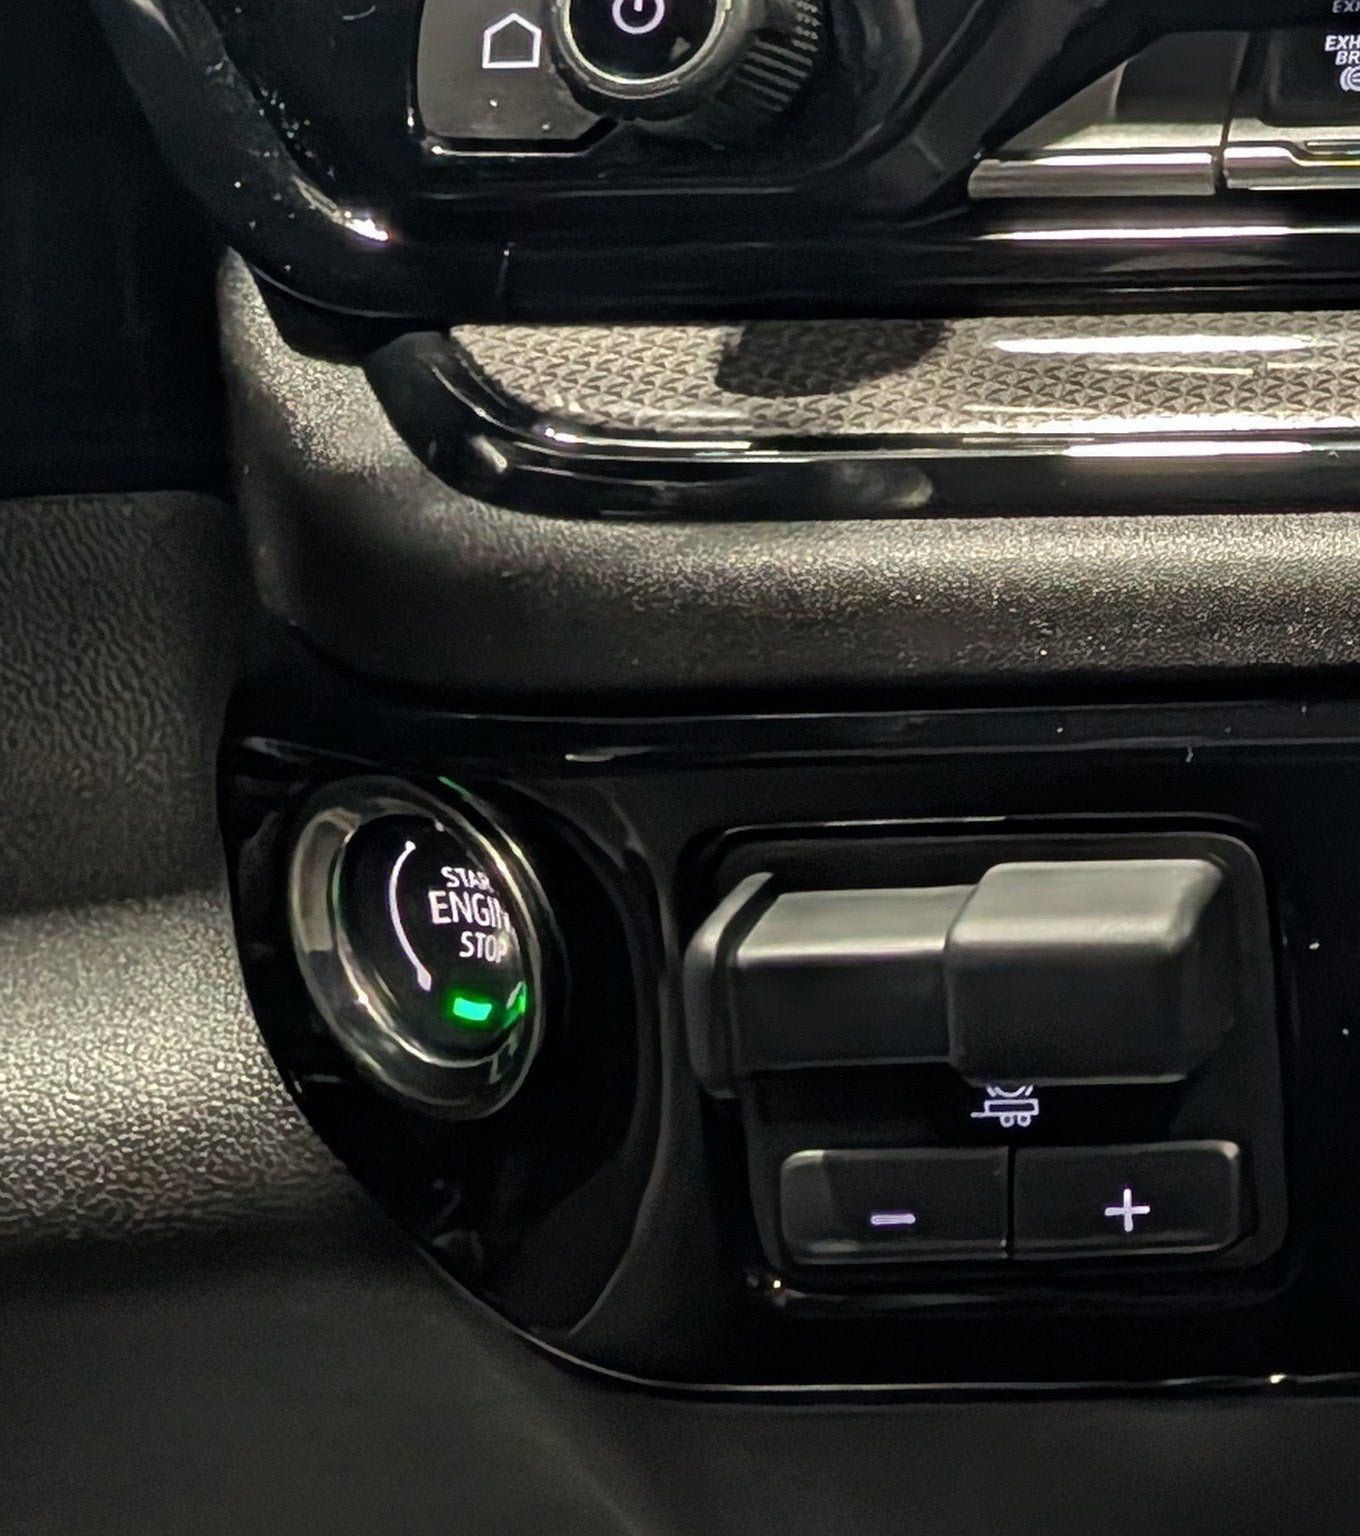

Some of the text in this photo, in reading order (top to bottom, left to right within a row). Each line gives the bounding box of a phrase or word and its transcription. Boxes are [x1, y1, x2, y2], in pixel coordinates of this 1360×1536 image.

[441, 866, 494, 893] STAR
[428, 889, 511, 932] ENGIN
[459, 930, 508, 963] STOP
